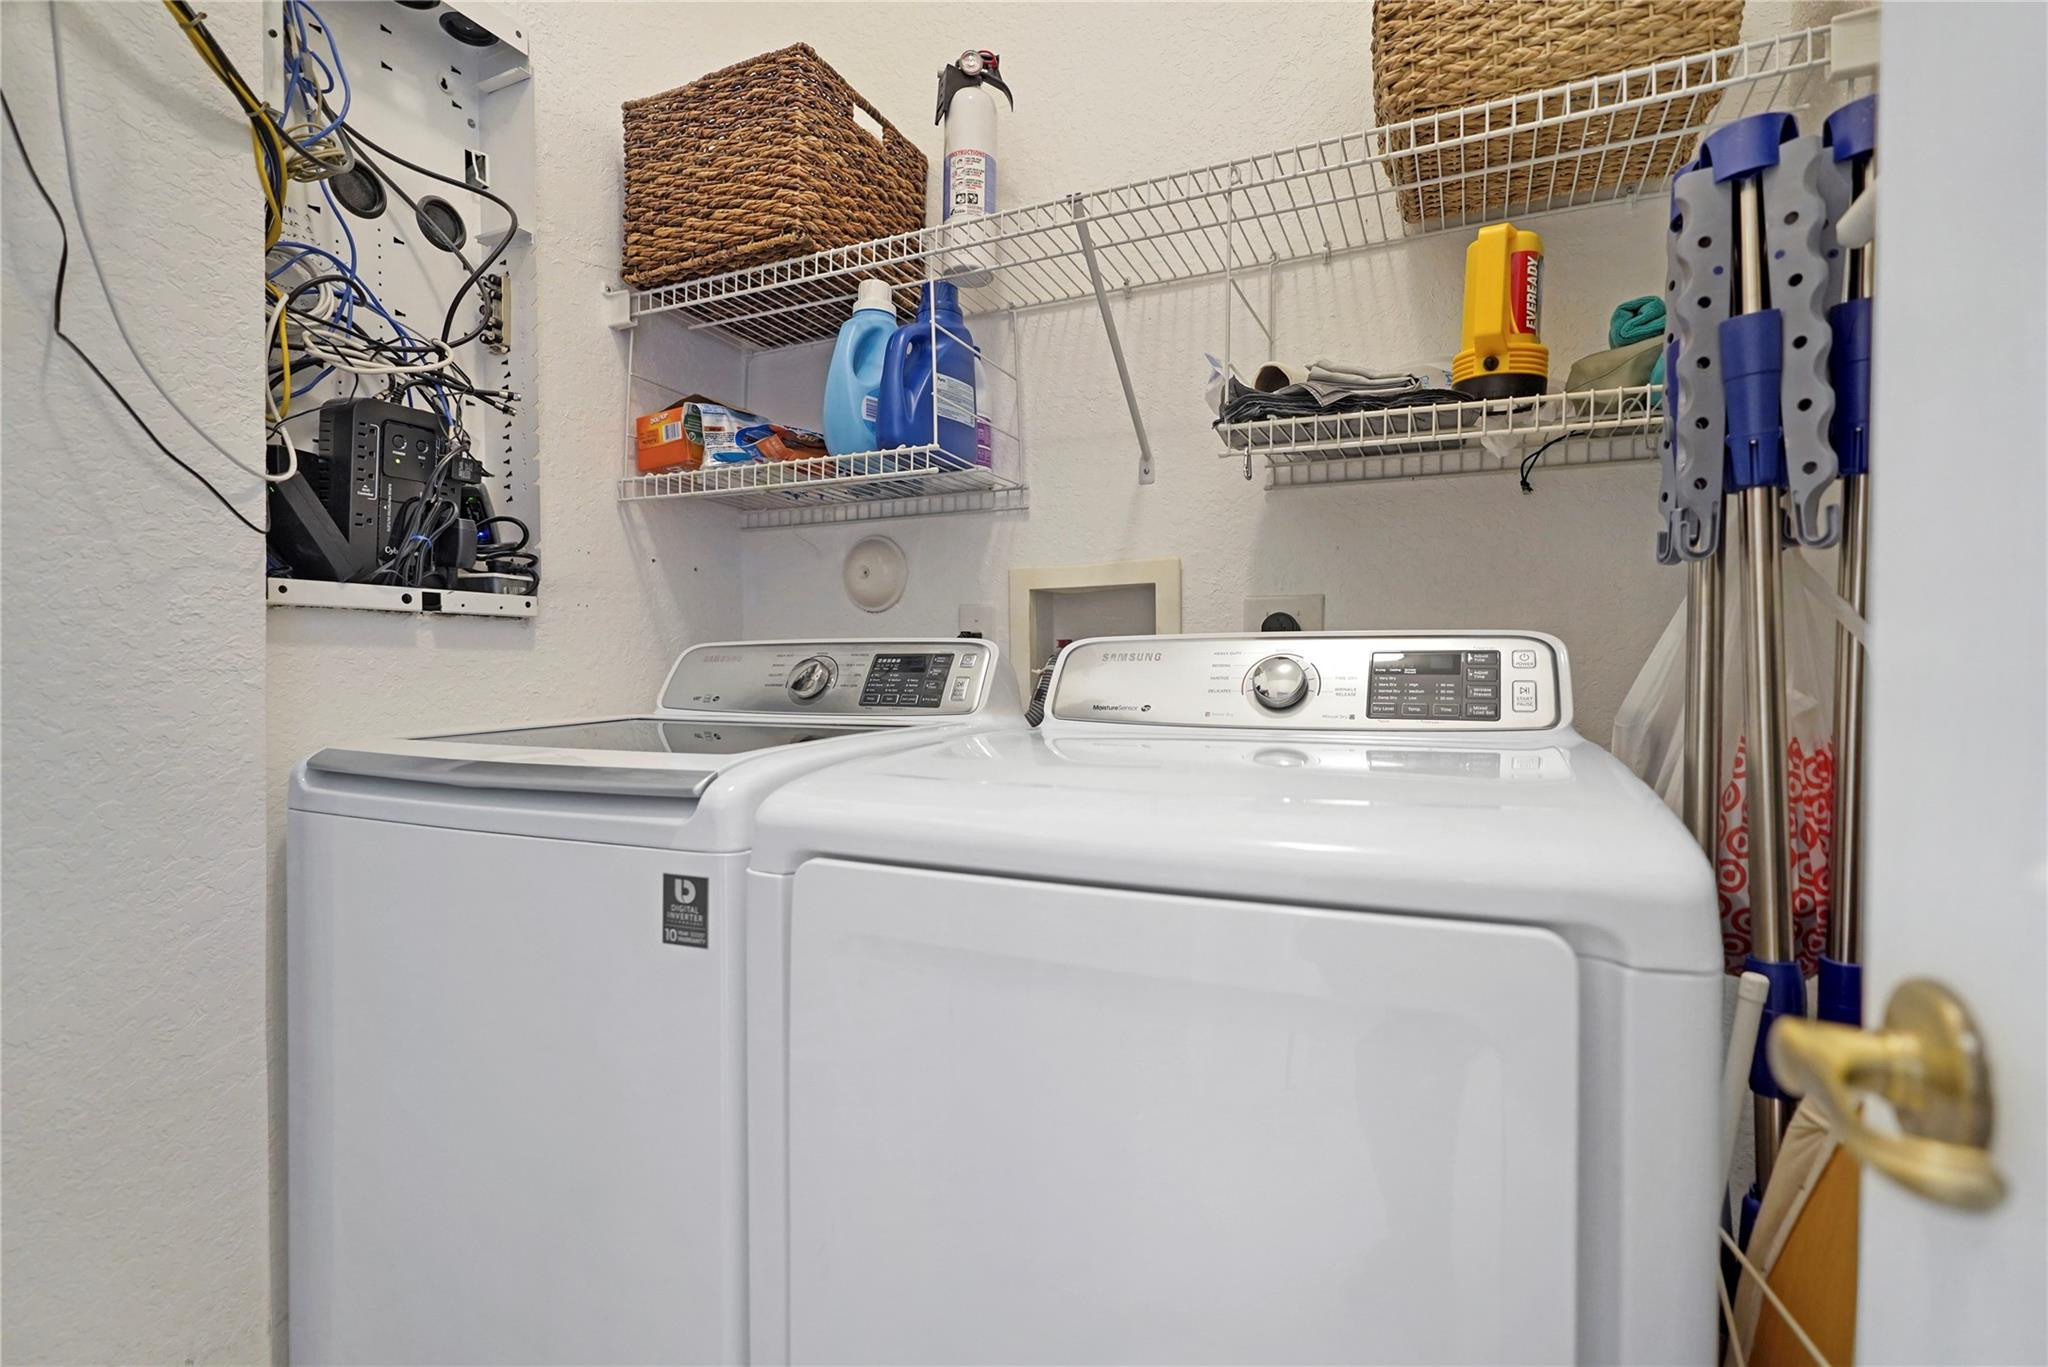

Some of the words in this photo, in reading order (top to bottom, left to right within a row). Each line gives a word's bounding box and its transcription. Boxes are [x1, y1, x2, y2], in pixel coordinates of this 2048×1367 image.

[1526, 255, 1538, 330] EVEREADY
[1102, 652, 1162, 662] SAMSUNG
[671, 904, 699, 914] DIGITAL
[666, 912, 703, 922] INVERTER
[664, 928, 677, 942] 10
